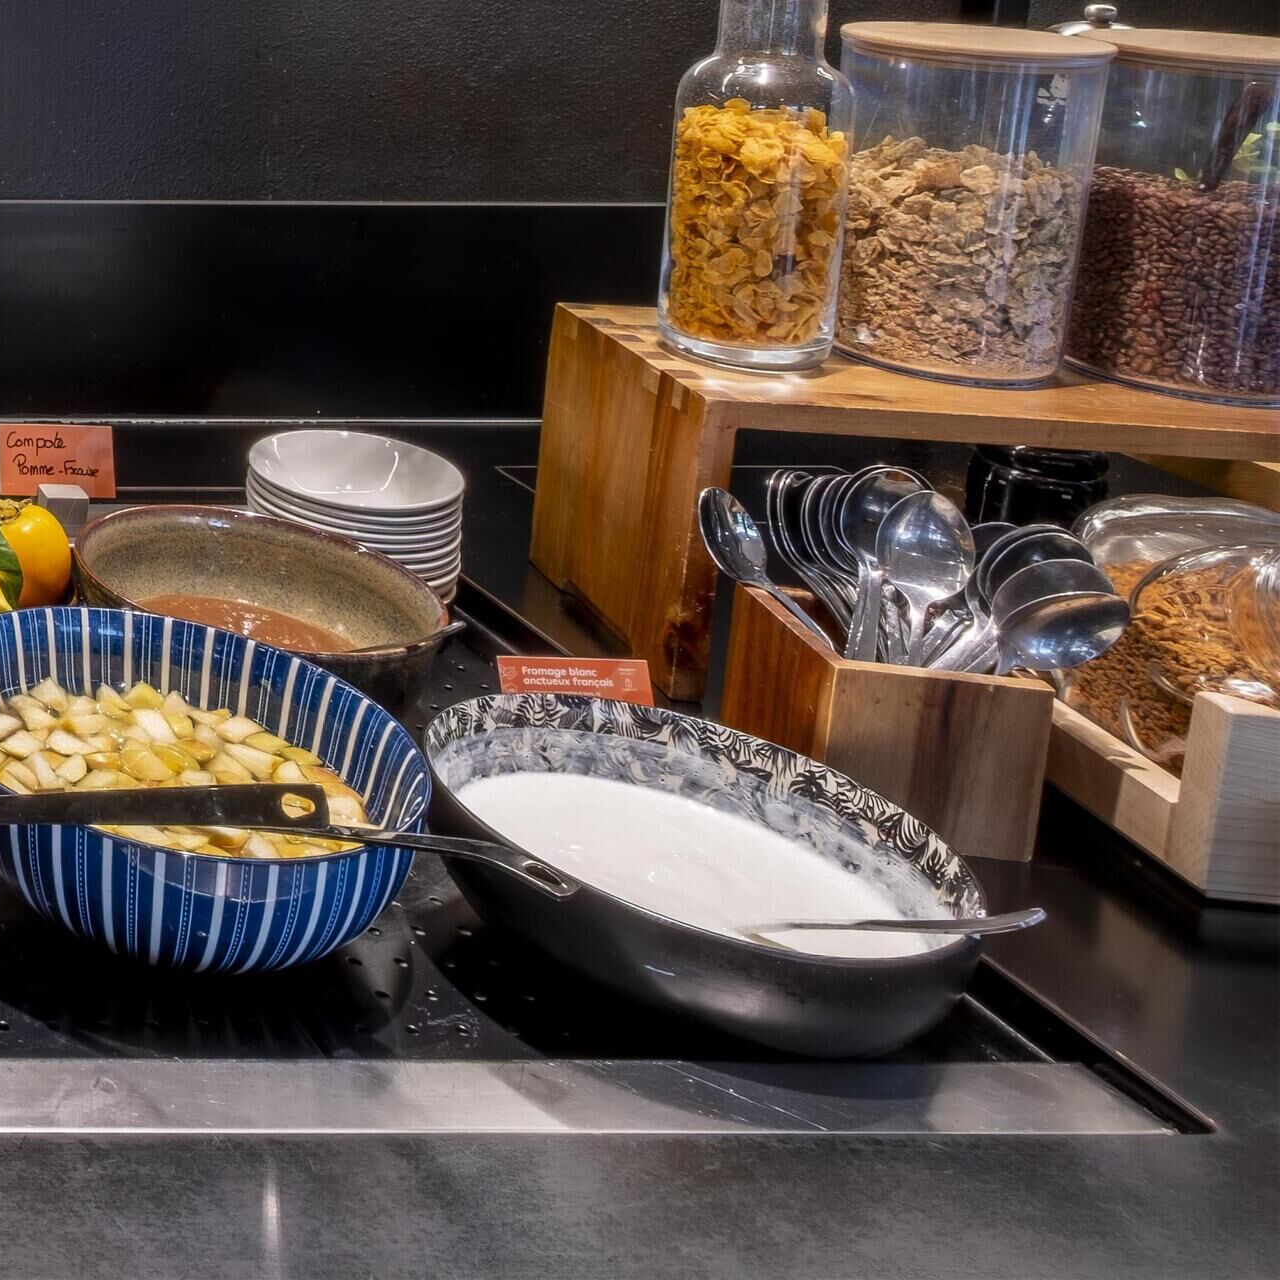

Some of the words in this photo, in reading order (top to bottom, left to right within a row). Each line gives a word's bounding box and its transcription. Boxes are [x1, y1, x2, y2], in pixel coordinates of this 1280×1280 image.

[6, 431, 67, 456] Compote
[521, 666, 567, 679] Fromage
[568, 666, 598, 677] blanc
[572, 677, 614, 688] français
